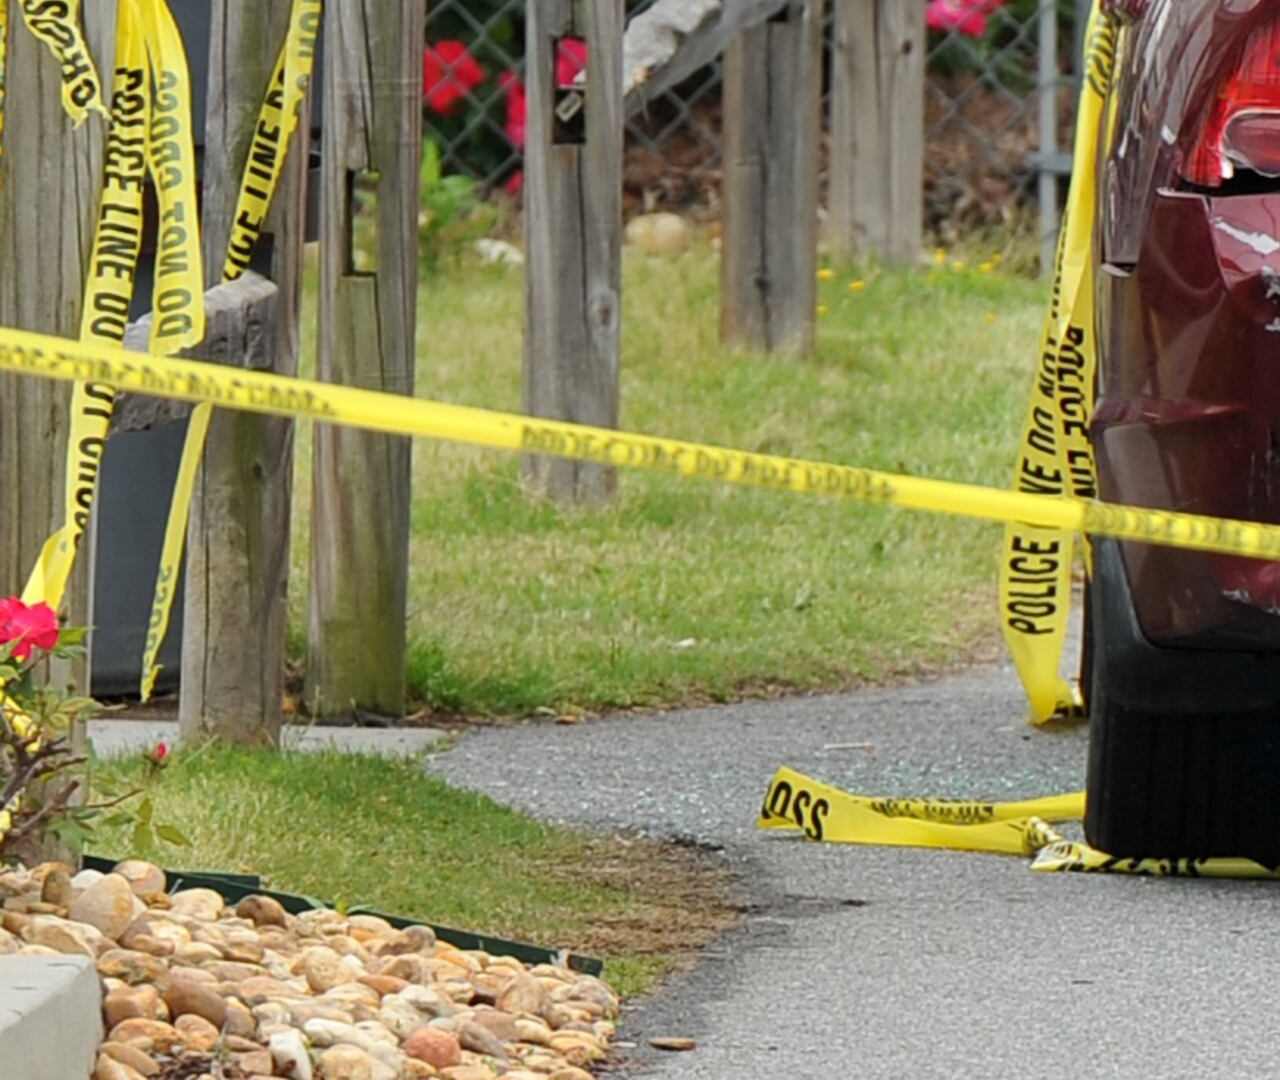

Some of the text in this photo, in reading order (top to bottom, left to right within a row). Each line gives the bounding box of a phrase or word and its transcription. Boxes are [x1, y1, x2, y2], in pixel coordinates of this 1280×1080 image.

[96, 203, 140, 284] LINE
[90, 292, 131, 342] DO
[1006, 535, 1060, 635] POLICE
